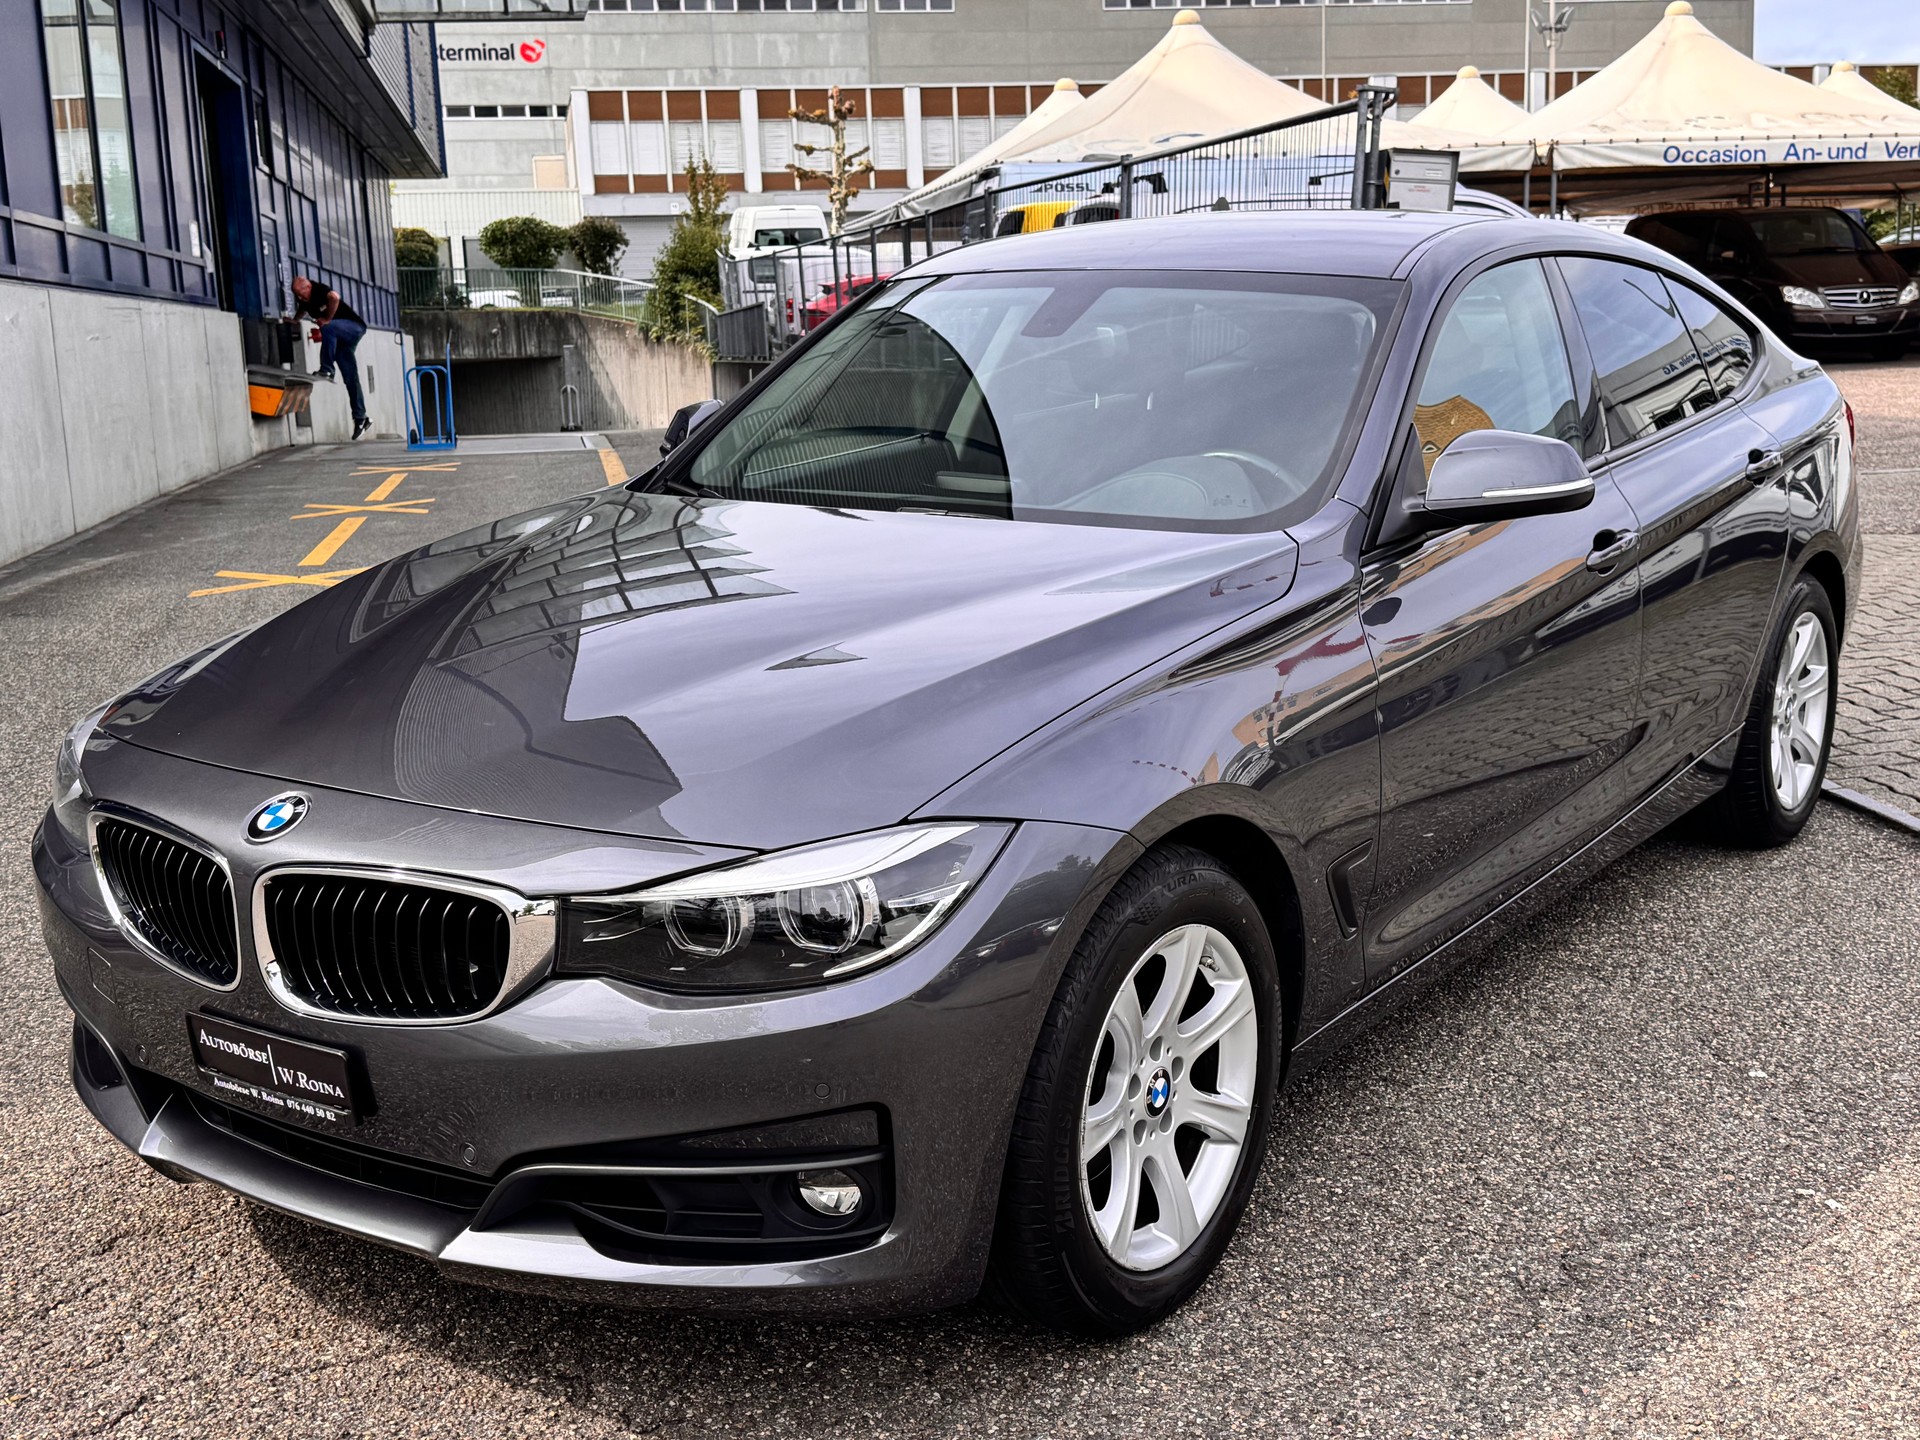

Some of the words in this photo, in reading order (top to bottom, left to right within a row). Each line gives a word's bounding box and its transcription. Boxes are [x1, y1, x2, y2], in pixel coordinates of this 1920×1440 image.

[438, 43, 515, 61] terminal
[1663, 145, 1767, 163] Occasion
[1884, 141, 1920, 159] Ver
[261, 1091, 284, 1106] Roina
[286, 1099, 300, 1111] 076
[301, 1103, 315, 1116] 440
[315, 1107, 325, 1119] 50
[325, 1110, 337, 1122] 82
